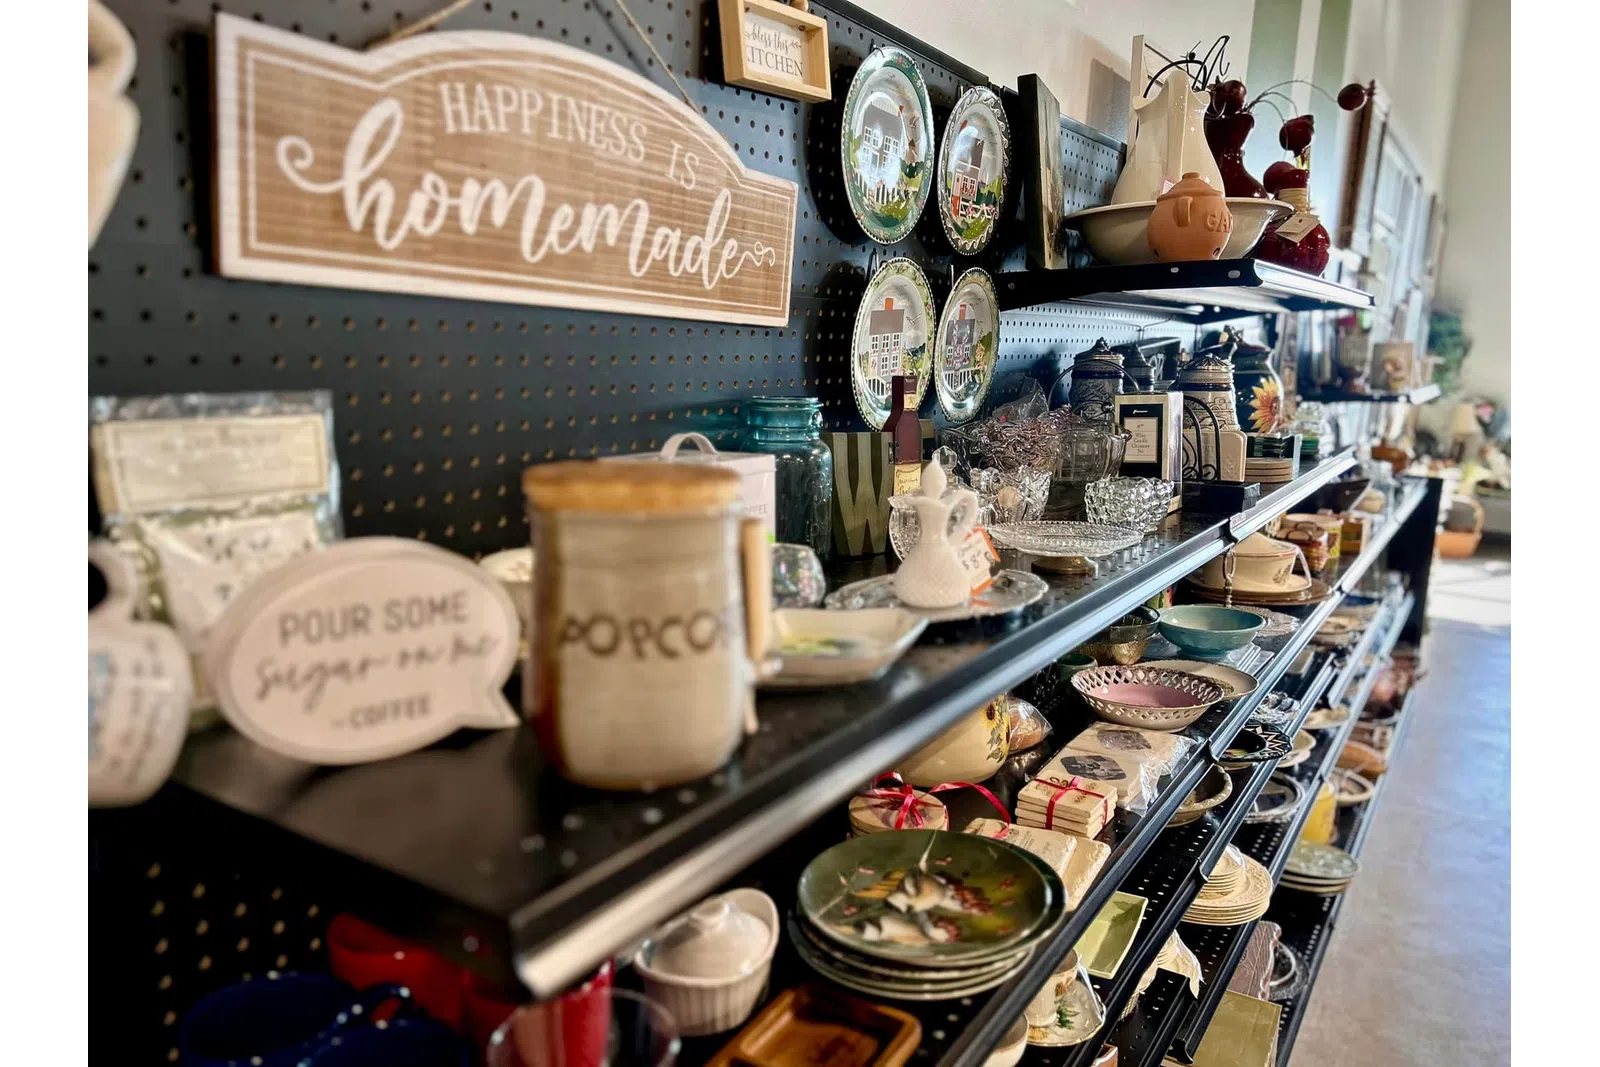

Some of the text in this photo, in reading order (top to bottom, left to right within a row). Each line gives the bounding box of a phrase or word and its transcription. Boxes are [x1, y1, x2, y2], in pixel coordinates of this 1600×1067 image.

[747, 46, 804, 77] ITCHEN
[440, 81, 700, 190] HAPPINESS IS
[275, 98, 775, 291] homemade
[832, 432, 895, 556] W
[277, 589, 469, 648] POUR SOME
[557, 609, 731, 660] POPCO
